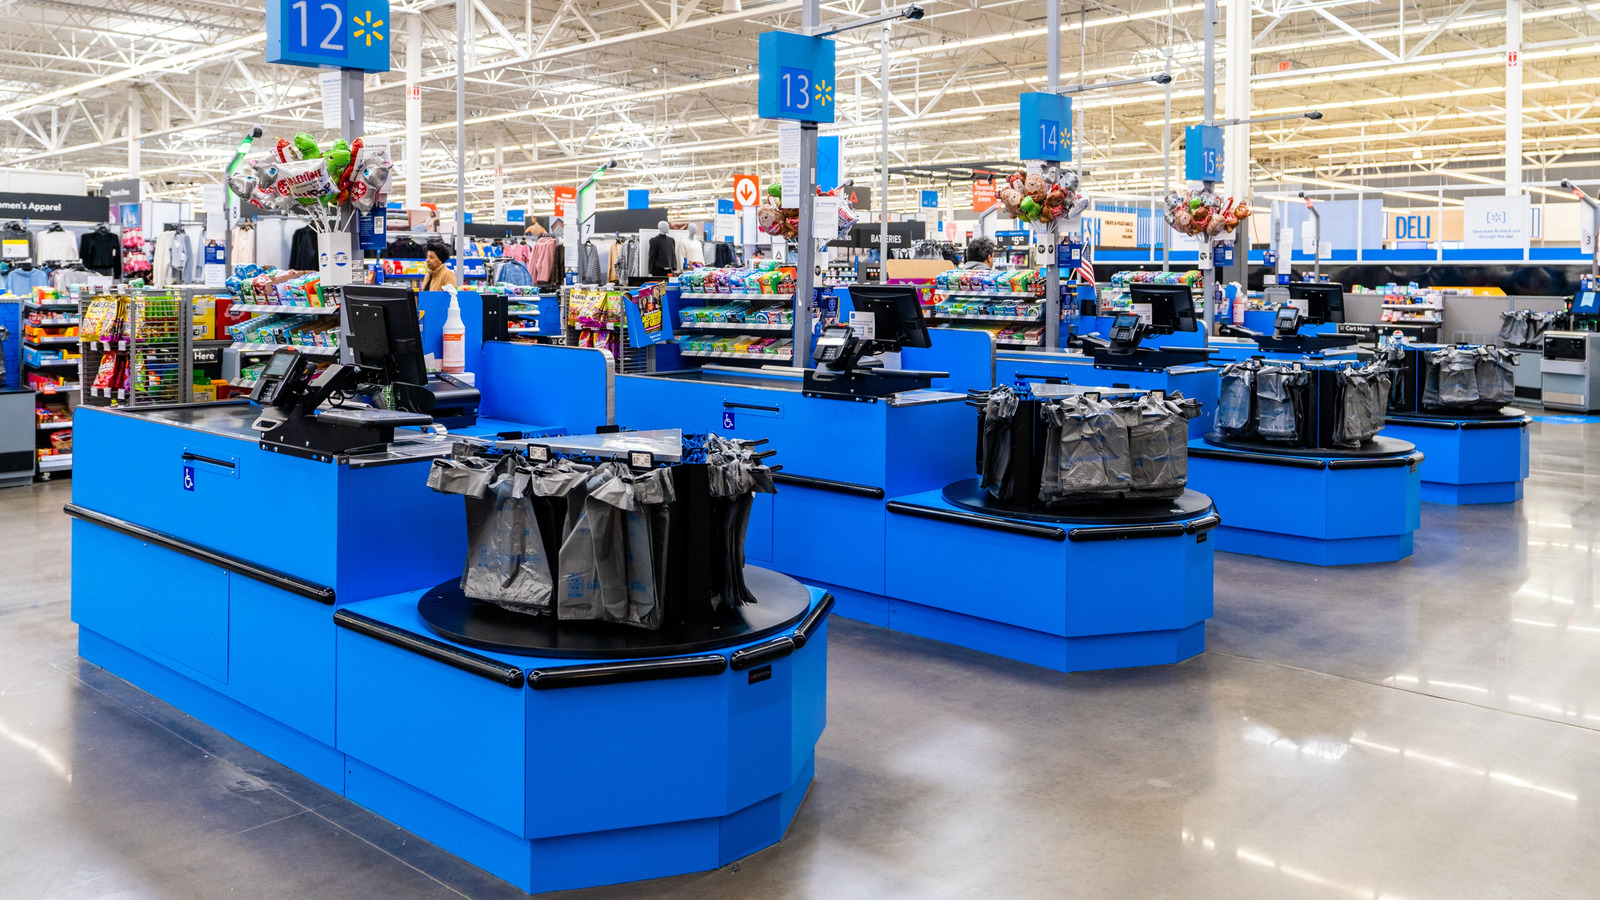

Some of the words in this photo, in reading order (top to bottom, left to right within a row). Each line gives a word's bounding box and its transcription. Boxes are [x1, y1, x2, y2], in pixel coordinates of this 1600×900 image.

[292, 1, 344, 50] 12
[782, 73, 810, 109] 13
[1040, 124, 1057, 151] 14
[1203, 151, 1215, 174] 15
[28, 201, 61, 213] Apparel
[233, 206, 237, 219] 8
[585, 224, 591, 234] 7
[1396, 215, 1430, 239] DELI
[870, 234, 902, 243] BATERIES
[1586, 235, 1591, 245] 3
[194, 352, 215, 360] Here
